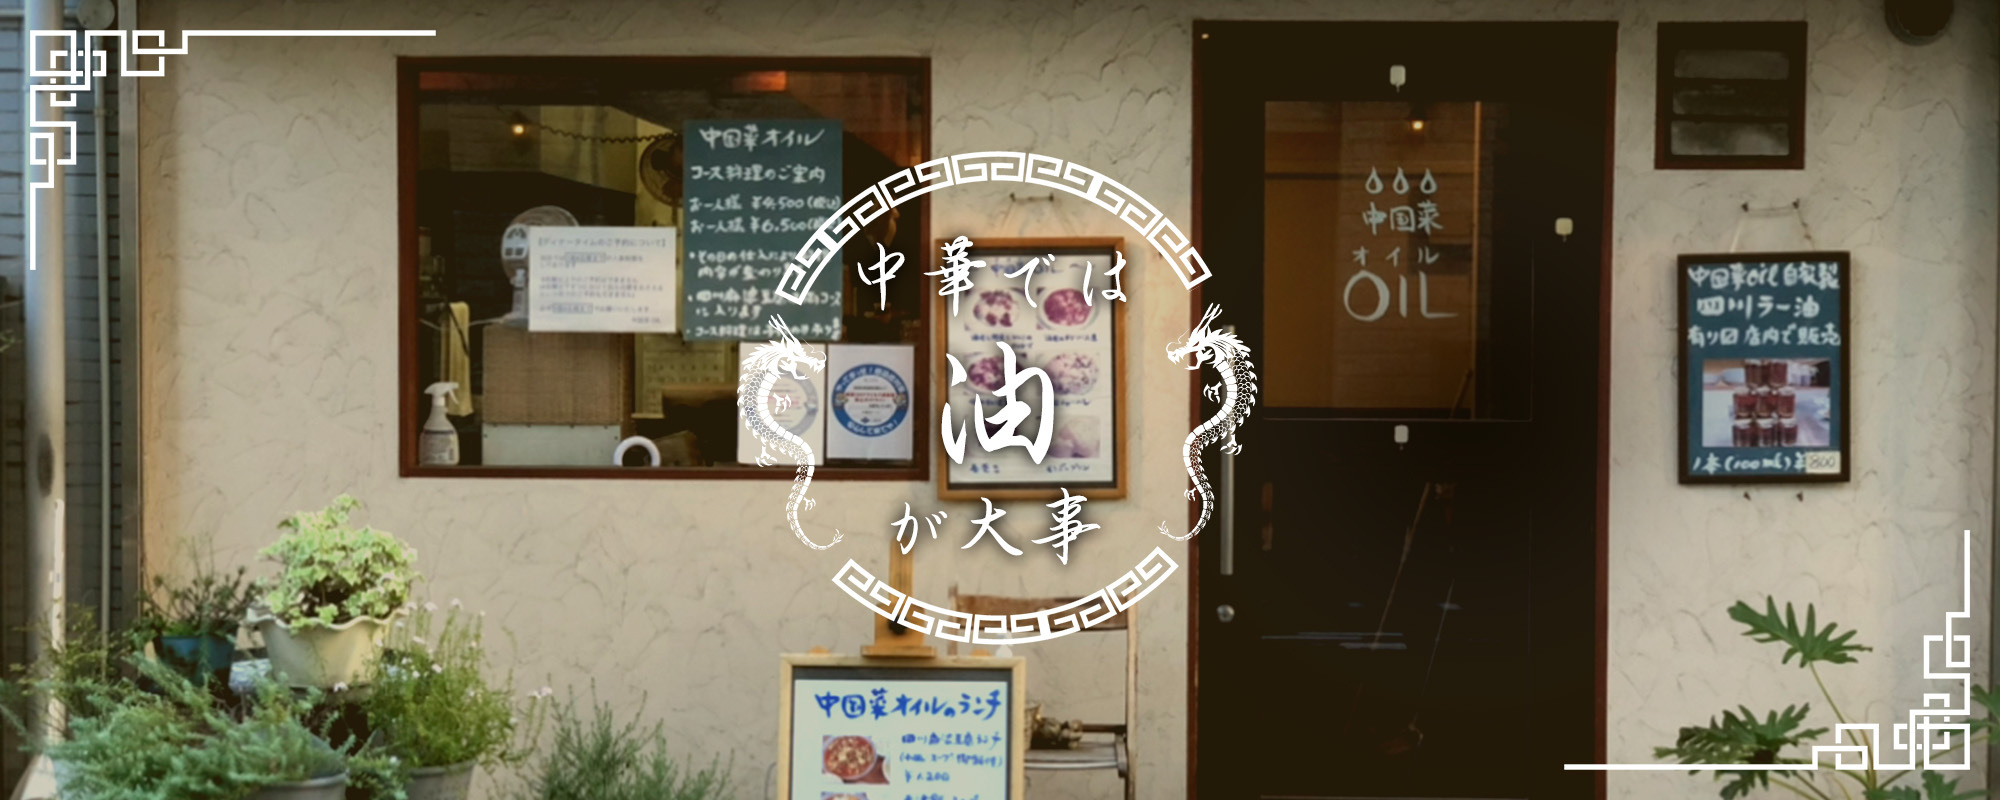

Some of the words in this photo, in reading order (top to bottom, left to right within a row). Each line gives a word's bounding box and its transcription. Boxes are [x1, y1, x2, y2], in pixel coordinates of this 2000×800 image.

[699, 124, 825, 152] 中国菜オイル
[691, 163, 826, 184] コース料理のご案内
[688, 194, 743, 212] お一人様
[689, 216, 745, 234] お一人様
[1362, 200, 1443, 236] 中国菜
[1352, 246, 1440, 267] オイル
[1343, 269, 1459, 322] OIL
[1697, 295, 1820, 320] 四川ラー油
[1744, 323, 1841, 346] 店内で販売
[814, 687, 1002, 721] 中国菜オイルのランチ
